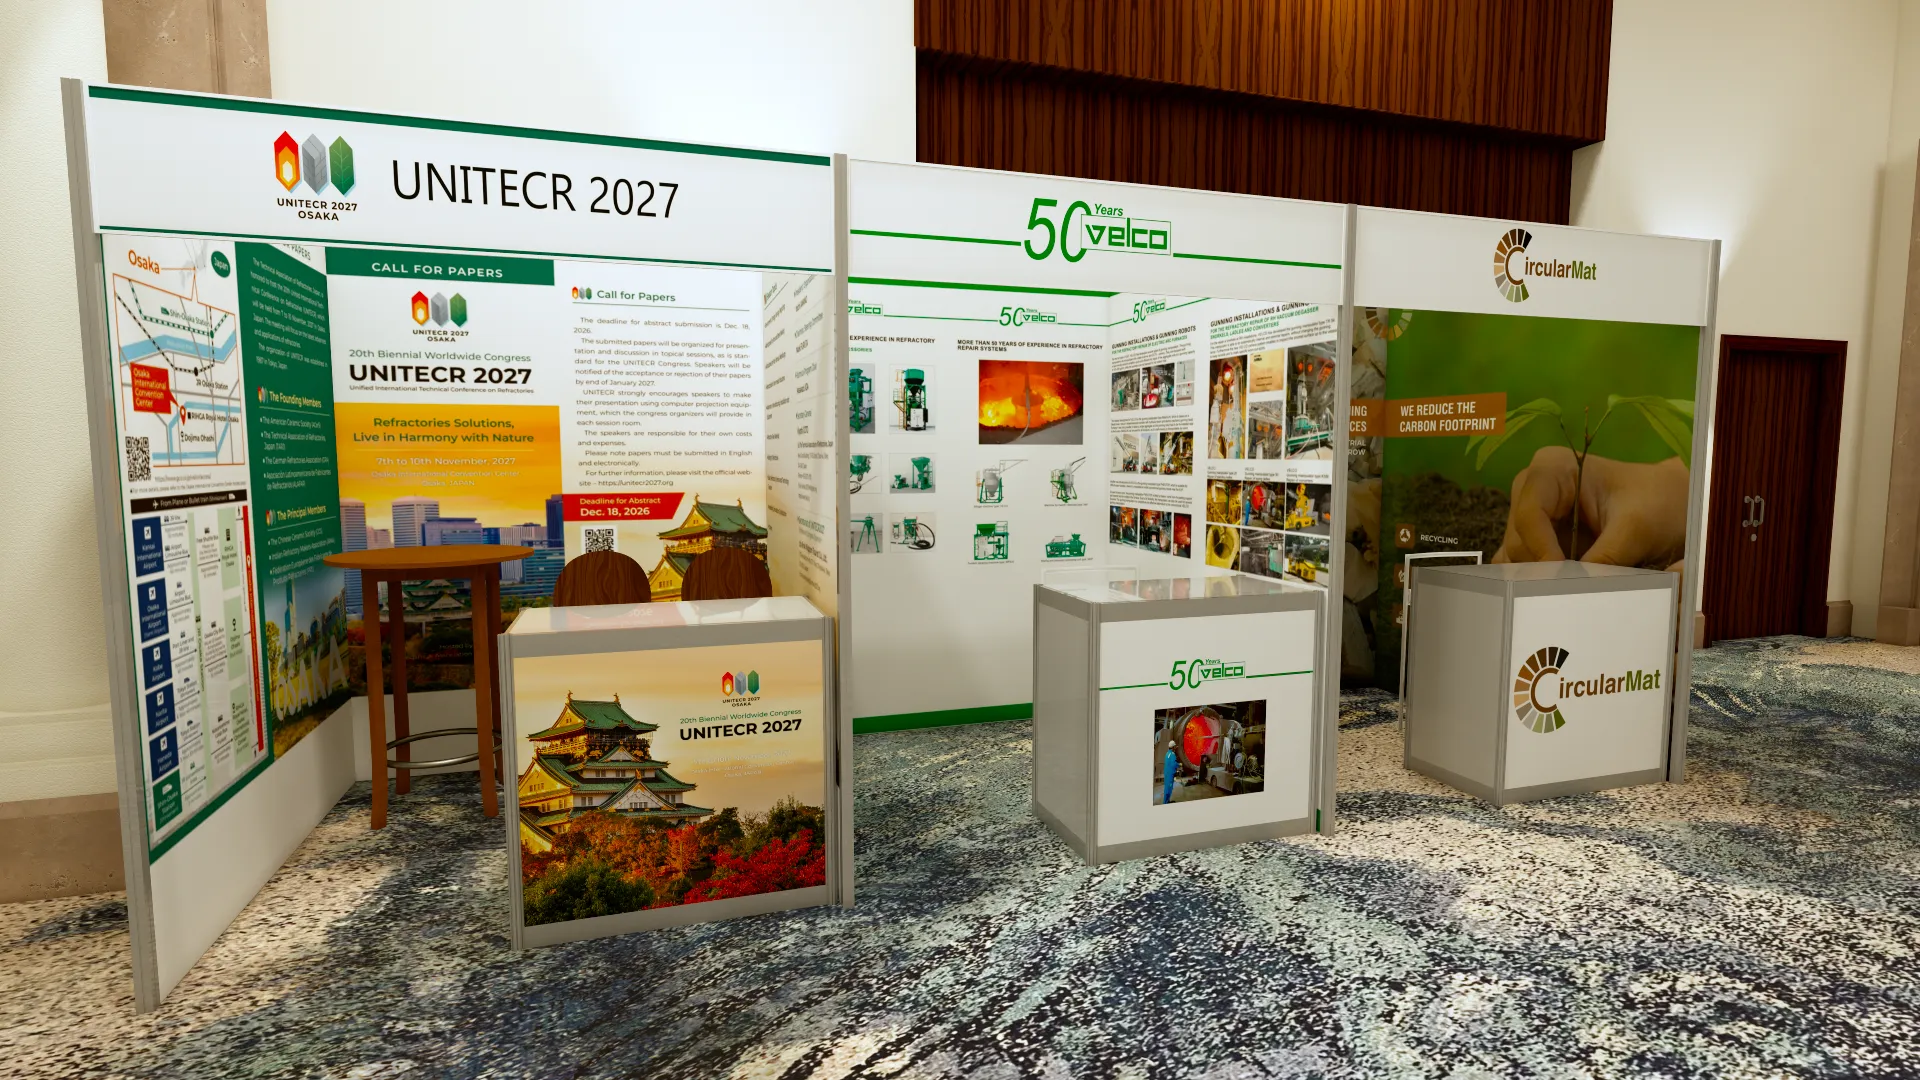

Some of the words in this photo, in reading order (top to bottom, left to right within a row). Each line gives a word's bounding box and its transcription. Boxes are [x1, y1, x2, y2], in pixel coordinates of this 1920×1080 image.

[393, 160, 576, 211] UNITECR
[590, 176, 678, 218] 2027
[277, 198, 327, 209] UNITECR
[331, 201, 357, 211] 2027
[1094, 203, 1124, 216] Years
[298, 210, 339, 221] OSAKA
[1024, 197, 1092, 263] 50
[1085, 217, 1168, 250] velco
[128, 249, 160, 275] Osaka
[213, 256, 229, 271] Japan
[372, 262, 408, 273] CALL
[414, 264, 442, 275] FOR
[448, 266, 503, 278] PAPERS
[596, 290, 617, 299] Call
[620, 291, 635, 300] for
[638, 292, 676, 303] Papers
[169, 308, 195, 323] Shin-Osaka
[999, 306, 1026, 327] 50
[1022, 311, 1056, 323] velco
[1132, 300, 1148, 323] 50
[1145, 302, 1166, 315] velco
[849, 335, 877, 343] EXPERIENCE
[349, 349, 375, 358] 20th
[378, 350, 422, 359] Biennial
[424, 352, 482, 361] Worldwide
[484, 353, 531, 363] Congress
[133, 367, 150, 378] Osaka
[349, 364, 466, 383] UNITECR
[473, 367, 532, 384] 2027
[134, 379, 167, 390] International
[214, 381, 229, 390] Station
[609, 379, 637, 387] January
[135, 388, 164, 398] Convention
[269, 391, 279, 401] The
[280, 392, 302, 407] Founding
[302, 398, 322, 408] Members
[135, 399, 154, 408] Center
[1400, 405, 1414, 416] WE
[1416, 402, 1454, 416] REDUCE
[1456, 401, 1476, 414] THE
[1350, 405, 1368, 416] ING
[373, 418, 451, 428] Refractories
[453, 418, 514, 429] Solutions,
[1400, 420, 1436, 432] CARBON
[1439, 417, 1496, 431] FOOTPRINT
[184, 434, 200, 442] Dojima
[200, 433, 215, 442] Ohashi
[353, 432, 380, 442] Live
[383, 432, 395, 442] in
[399, 433, 458, 444] Harmony
[461, 433, 489, 442] with
[492, 434, 534, 443] Nature
[376, 457, 388, 466] 7th
[409, 457, 432, 465] 10th
[492, 457, 516, 465] 2027
[160, 499, 172, 508] From
[172, 498, 183, 506] Plane
[277, 511, 287, 520] The
[287, 508, 307, 520] Principal
[308, 505, 327, 515] Members
[580, 508, 605, 516] Dec.
[607, 507, 622, 517] 18,
[624, 507, 650, 516] 2026
[1420, 534, 1458, 545] RECYCLING
[1169, 658, 1204, 691] 50
[1200, 663, 1244, 679] velco
[698, 714, 728, 723] Biennial
[730, 712, 768, 720] Worldwide
[680, 723, 757, 741] UNITECR
[762, 718, 802, 734] 2027
